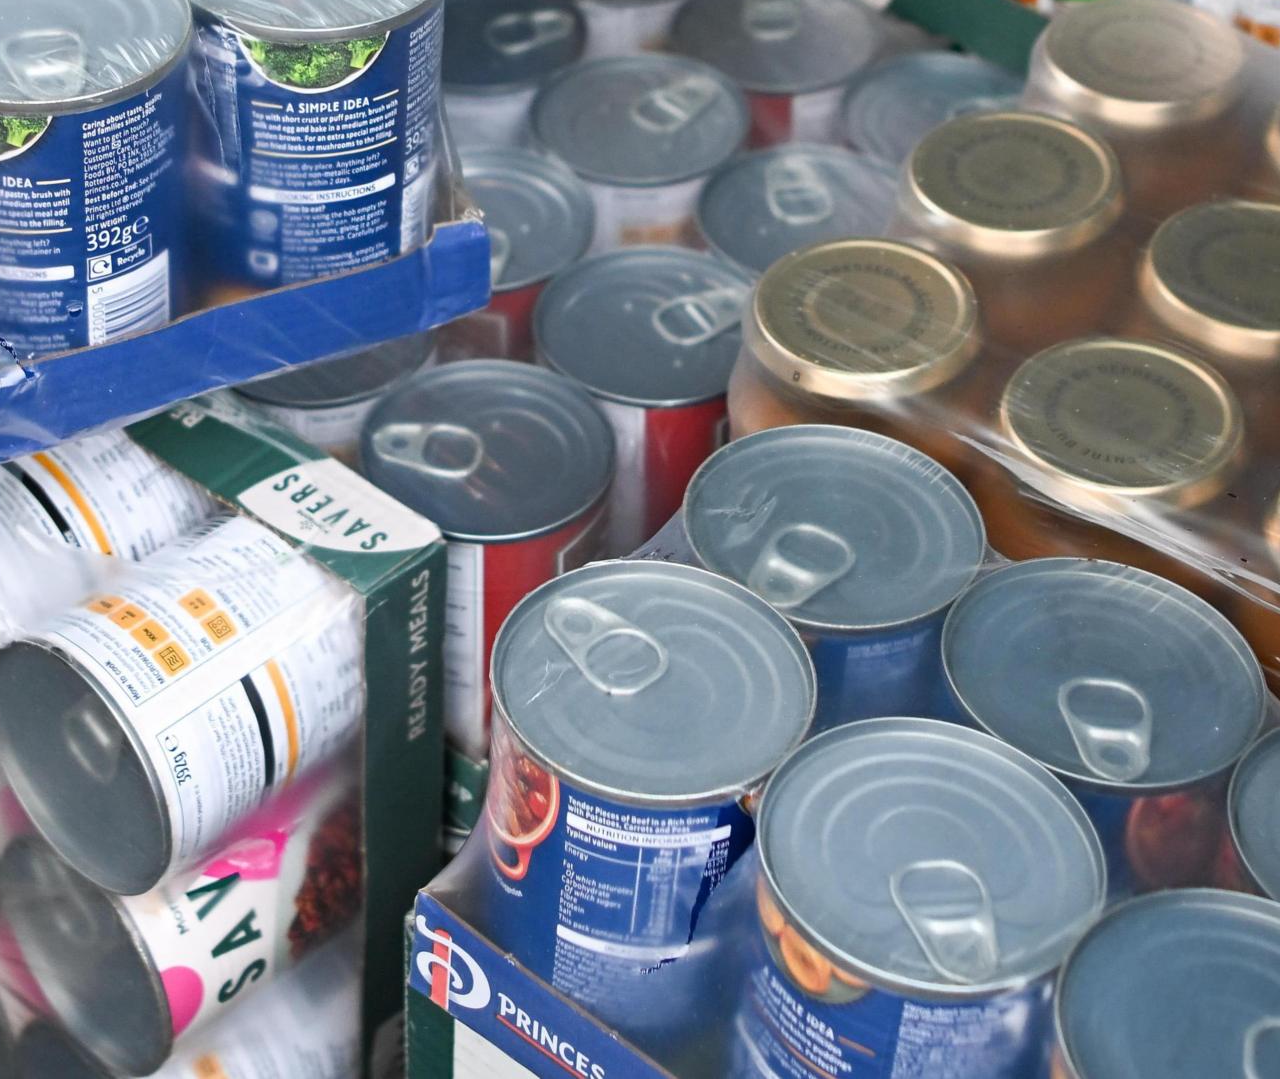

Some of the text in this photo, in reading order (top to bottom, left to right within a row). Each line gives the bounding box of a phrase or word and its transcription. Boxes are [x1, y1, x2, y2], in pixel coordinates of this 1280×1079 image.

[282, 105, 385, 125] short crust puff brush
[286, 96, 370, 114] A SIMPLE IDEA
[82, 110, 127, 132] Caring about
[82, 114, 141, 140] and families since
[282, 119, 369, 135] egg and bake in medium
[82, 117, 150, 149] Want to get in touch?
[279, 123, 384, 143] brown. For extra special meal
[316, 140, 356, 152] mushrooms
[364, 134, 375, 145] the
[82, 132, 140, 157] You can write
[83, 149, 116, 165] Customer
[83, 157, 118, 174] Liverpool,
[301, 151, 381, 172] dry Anything left?
[83, 168, 106, 181] Foods
[117, 160, 128, 171] PO
[128, 154, 140, 166] Box
[84, 166, 136, 189] Rotterdam, The
[351, 161, 381, 176] container
[2, 176, 33, 188] IDEA
[84, 177, 129, 198] princes.co.uk
[307, 176, 329, 186] within
[4, 188, 71, 200] pastry, brush with
[84, 188, 125, 206] Best Before
[316, 184, 377, 202] INSTRUCTIONS
[2, 198, 71, 209] medium oven until
[34, 208, 68, 218] meal add
[85, 197, 122, 215] Princes Ltd
[331, 199, 387, 219] the hob empty the
[29, 219, 42, 228] the
[85, 206, 116, 223] All rights
[85, 214, 129, 234] NET WEIGHT:
[347, 226, 375, 240] Carefully
[117, 247, 146, 266] Recycle
[271, 472, 389, 552] SAVERS
[130, 644, 167, 686] MICROWAVE
[407, 567, 431, 743] READY MEALS
[104, 659, 121, 675] cook
[125, 681, 141, 701] How
[172, 750, 192, 788] 392g
[567, 803, 691, 834] with Potatoes, Carrots and Peas
[568, 795, 686, 826] Tender Pieces of Beef in Rich
[566, 825, 617, 852] Typical values
[586, 822, 712, 845] NUTRITION INFORMATION
[565, 843, 589, 862] Energy
[562, 859, 574, 871] Fat
[561, 874, 611, 899] Carbohydrate
[565, 867, 634, 896] Of which saturates
[559, 896, 586, 915] Protein
[560, 888, 578, 905] Fibre
[564, 883, 622, 910] Of which sugars
[558, 904, 572, 917] Salt
[558, 911, 572, 926] This
[572, 920, 590, 933] pack
[770, 975, 835, 1042] SIMPLE IDEA
[496, 991, 606, 1079] PRINCES
